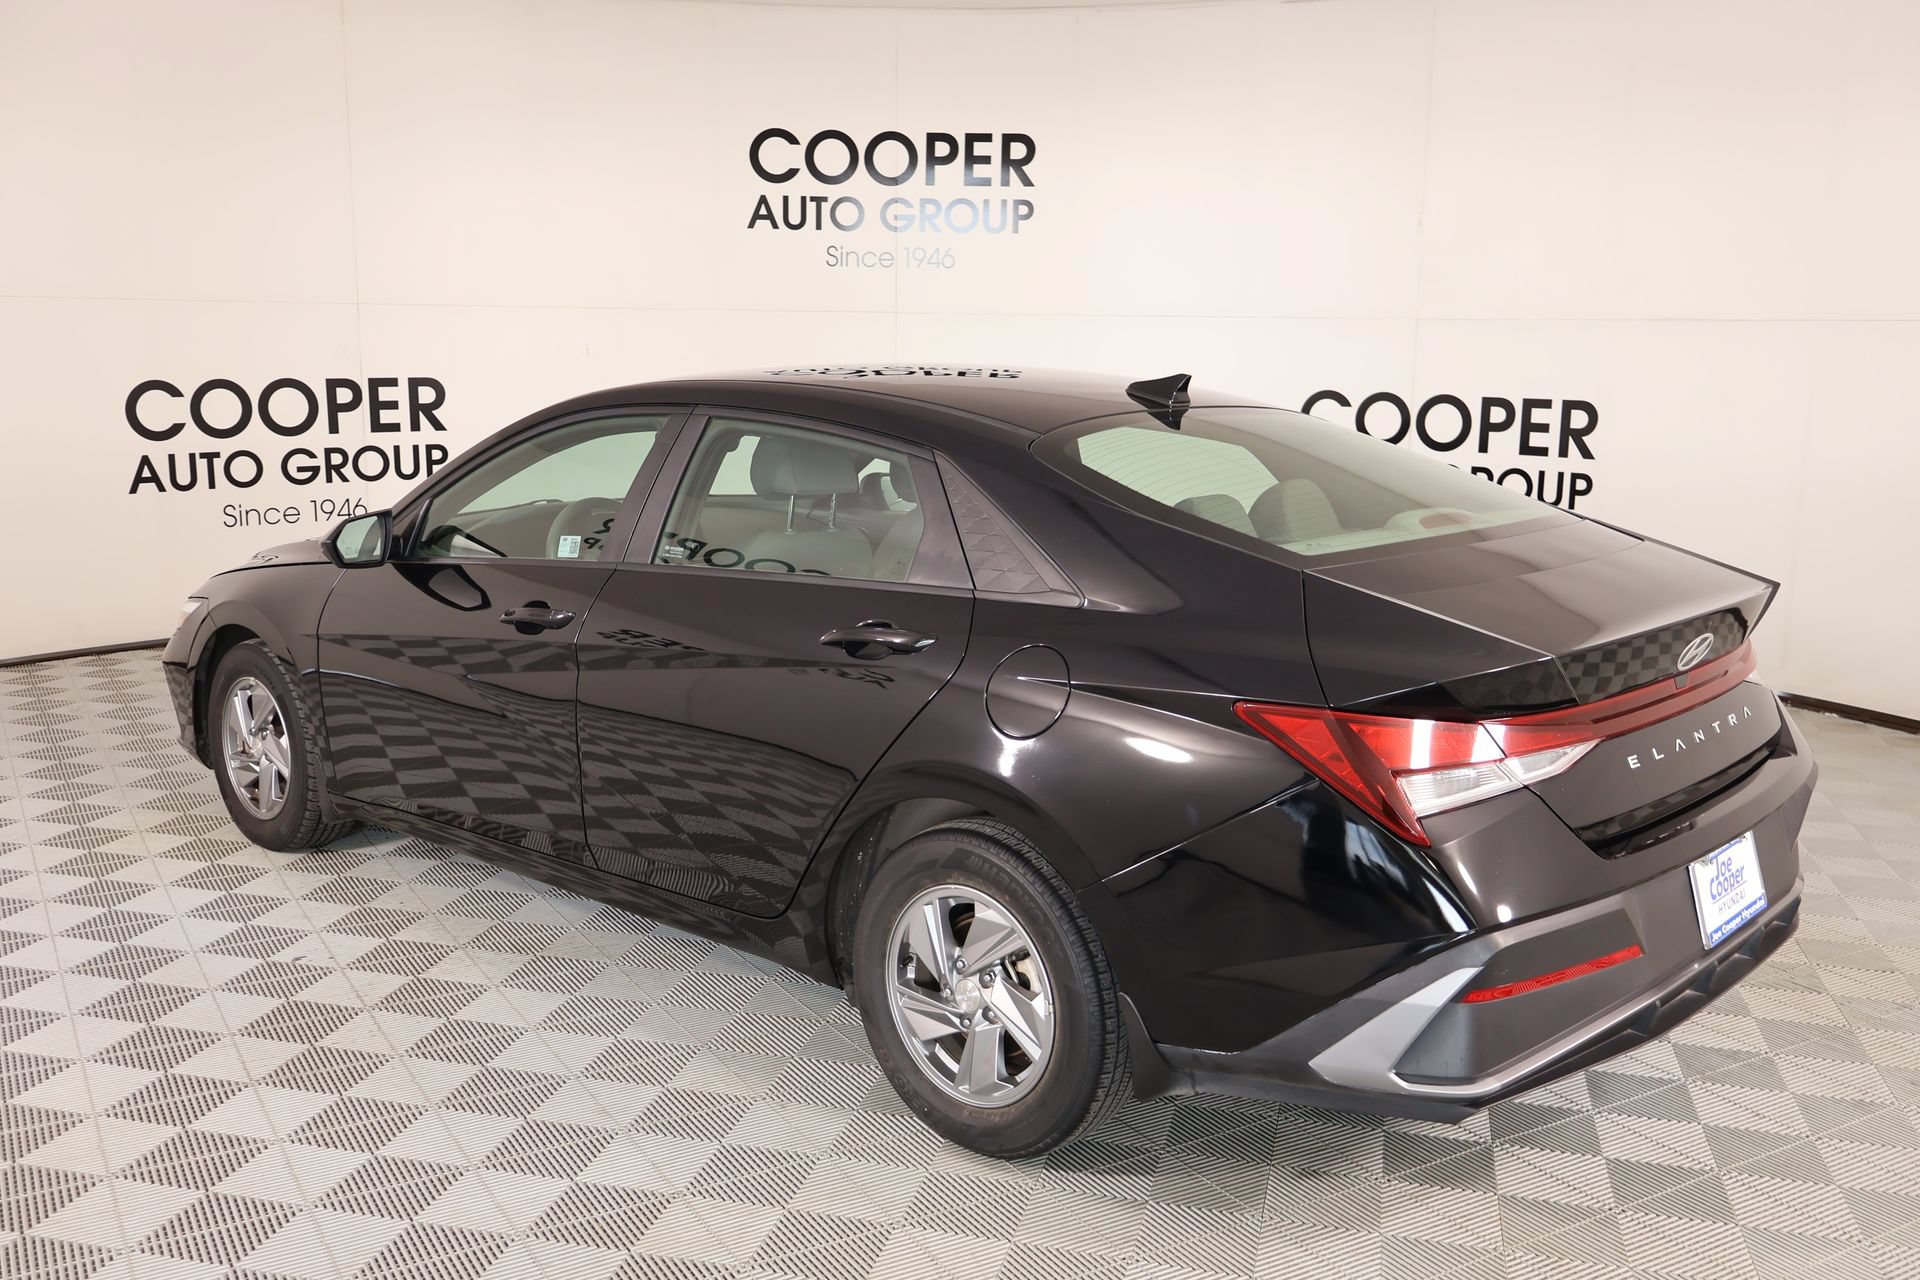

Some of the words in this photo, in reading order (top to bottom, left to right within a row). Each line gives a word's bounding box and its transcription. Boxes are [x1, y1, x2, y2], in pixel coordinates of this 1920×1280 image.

[749, 127, 1036, 187] COOPER
[747, 194, 865, 232] AUTO
[879, 196, 1034, 234] GROUP
[825, 245, 895, 268] Since
[903, 246, 956, 269] 1946
[125, 377, 447, 441] COOPER
[128, 449, 263, 494] AUTO
[281, 443, 448, 486] GROUP
[223, 503, 301, 528] Since
[1627, 706, 1752, 769] ELANTRA
[1710, 864, 1745, 901] Cooper
[1715, 856, 1732, 881] Joe
